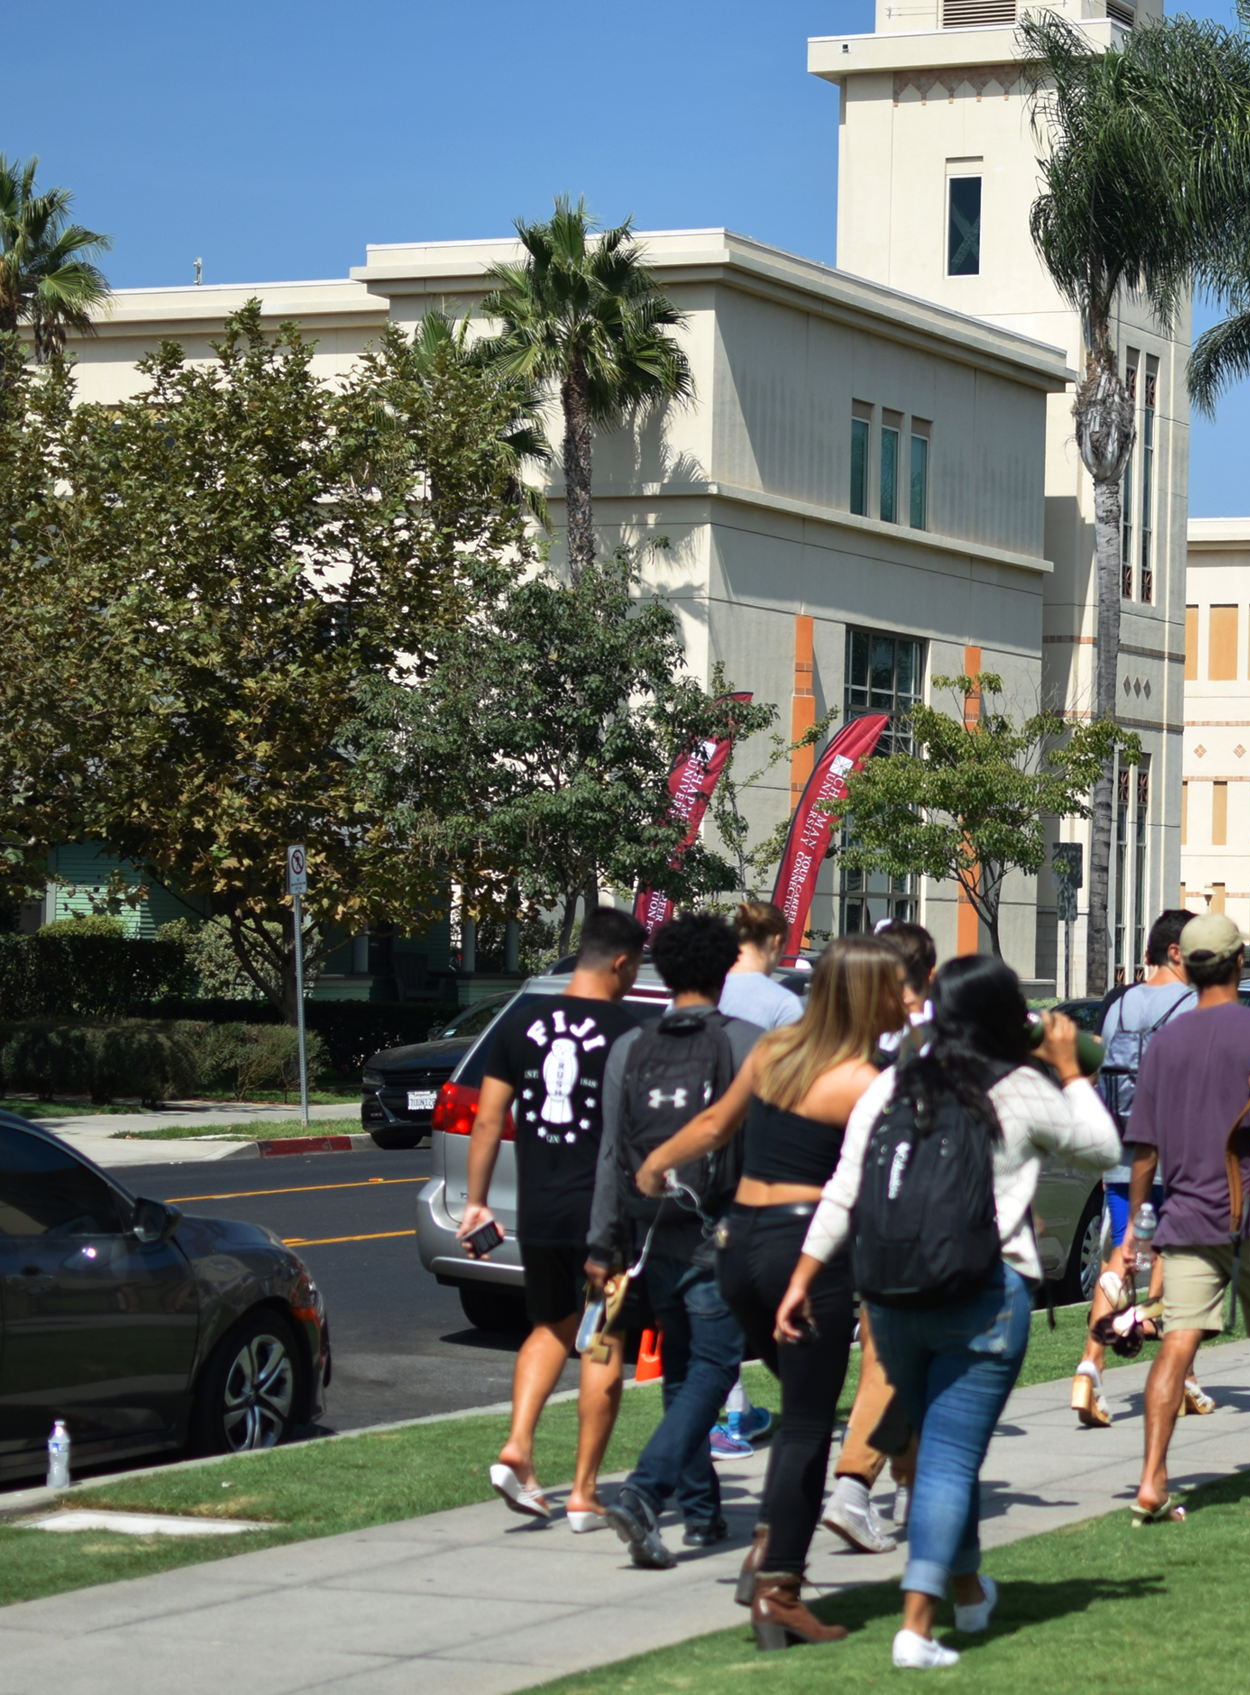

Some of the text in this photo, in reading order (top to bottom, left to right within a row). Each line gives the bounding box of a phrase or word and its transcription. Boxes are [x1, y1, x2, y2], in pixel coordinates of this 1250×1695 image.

[808, 777, 845, 850] CHMAN
[782, 851, 804, 919] CONNECTIO
[787, 855, 812, 924] YOUR CAREER
[526, 1010, 606, 1052] FIJI
[555, 1062, 565, 1096] RUSH
